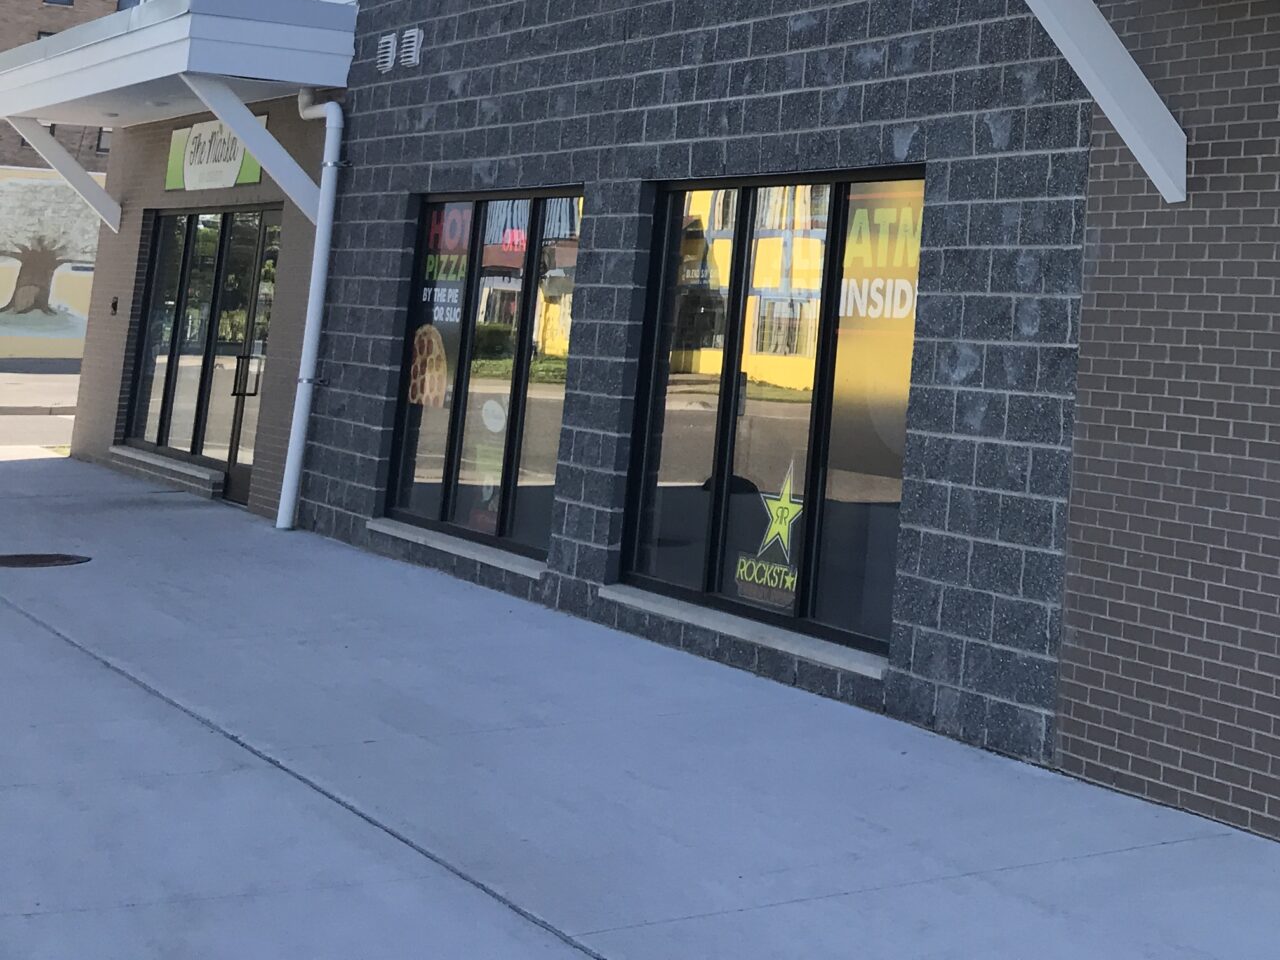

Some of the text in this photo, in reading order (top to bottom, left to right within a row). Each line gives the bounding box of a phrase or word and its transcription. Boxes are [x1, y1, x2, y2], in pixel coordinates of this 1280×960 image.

[190, 133, 206, 165] The
[425, 254, 467, 281] PIZZA
[422, 287, 460, 304] BY THE PIE
[838, 277, 918, 320] INSID
[736, 557, 798, 592] ROCKST
